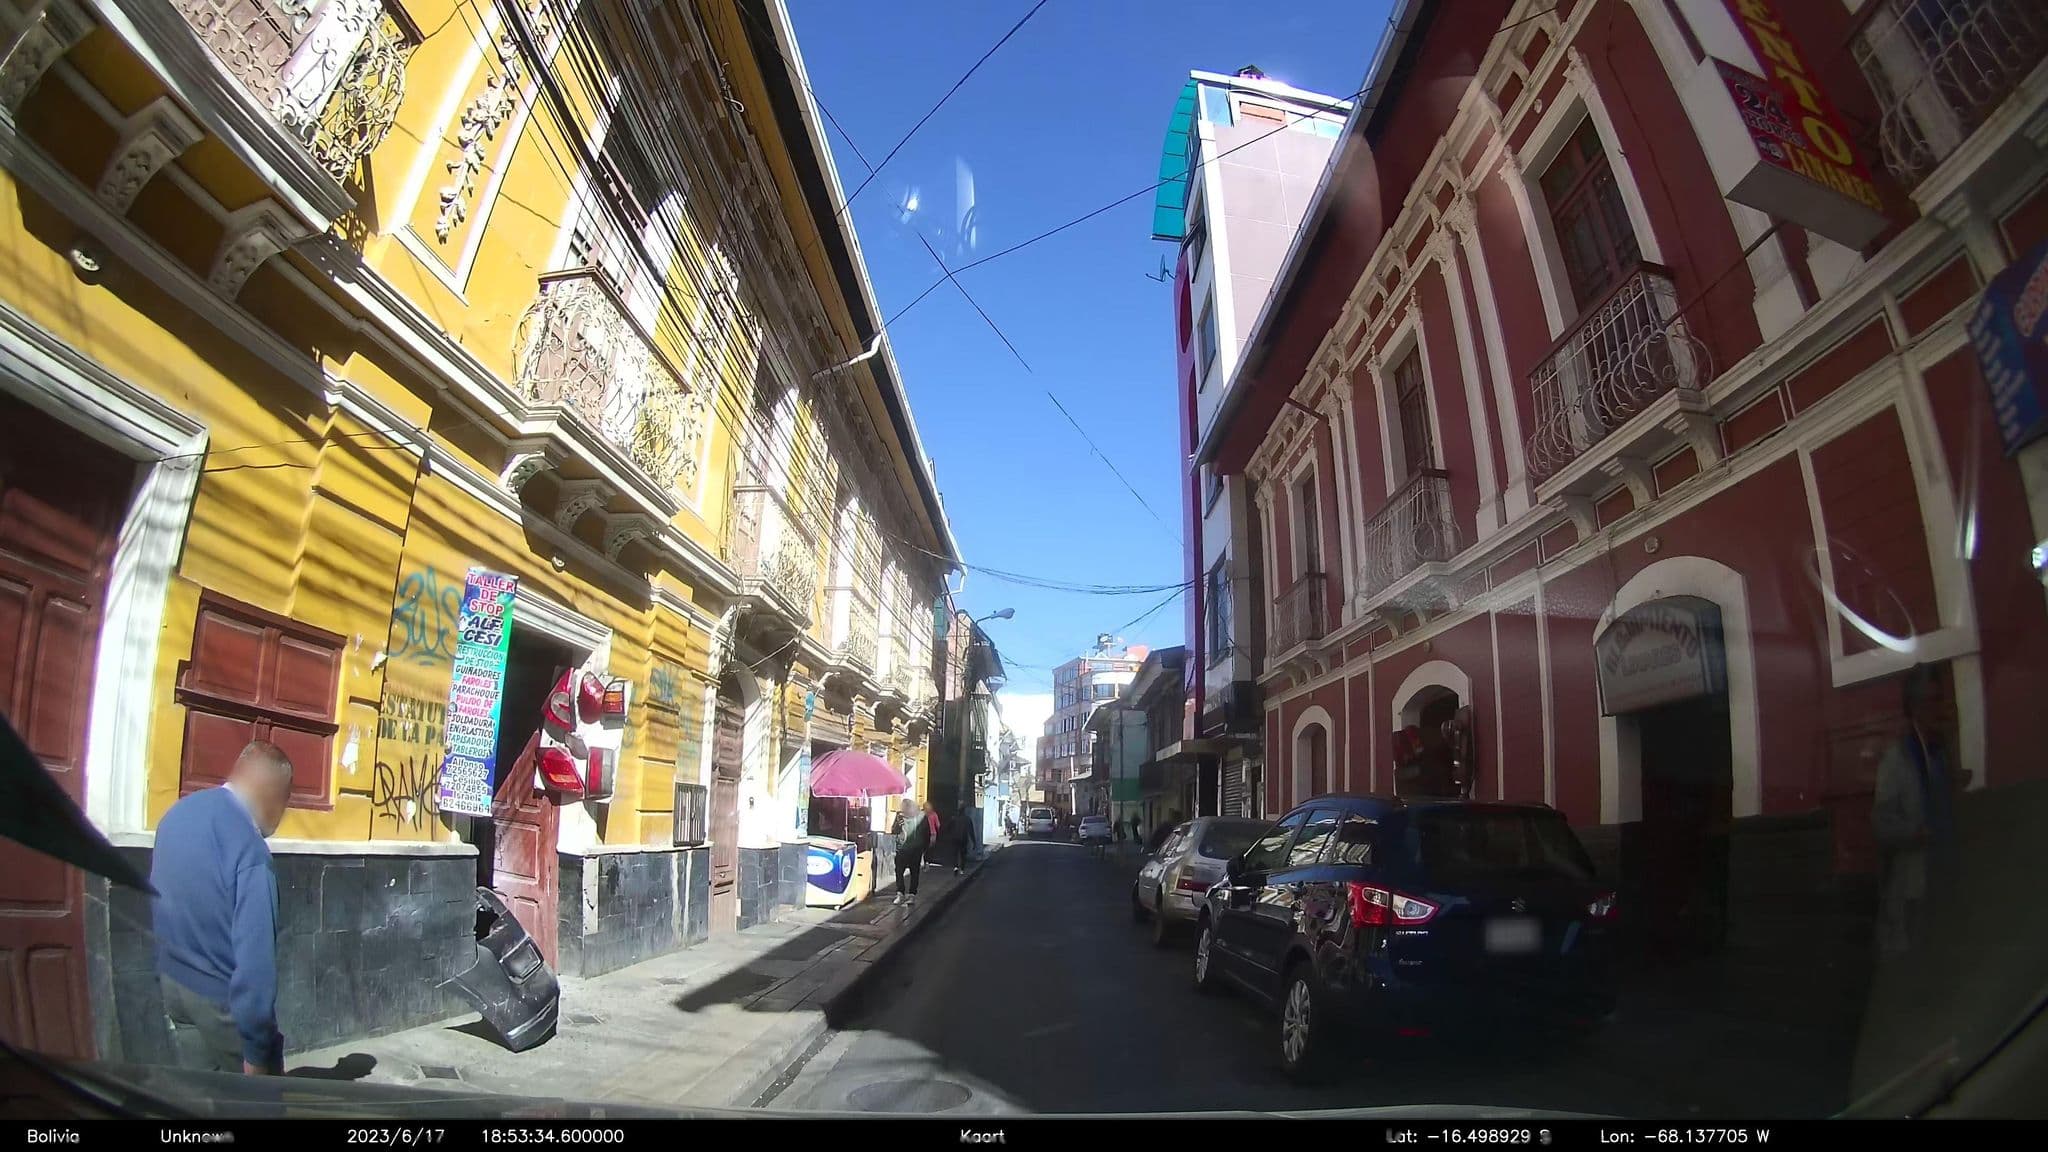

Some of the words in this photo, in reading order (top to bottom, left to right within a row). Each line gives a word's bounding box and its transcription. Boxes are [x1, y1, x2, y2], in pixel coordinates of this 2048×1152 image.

[467, 573, 514, 592] TALLER
[481, 589, 498, 601] DE
[470, 601, 504, 615] STOP
[463, 629, 502, 646] CESI
[465, 656, 475, 666] DE
[462, 675, 493, 688] FAROLES
[456, 694, 482, 706] PULIDO
[483, 699, 494, 708] DE
[451, 713, 493, 729] SOLDADURA
